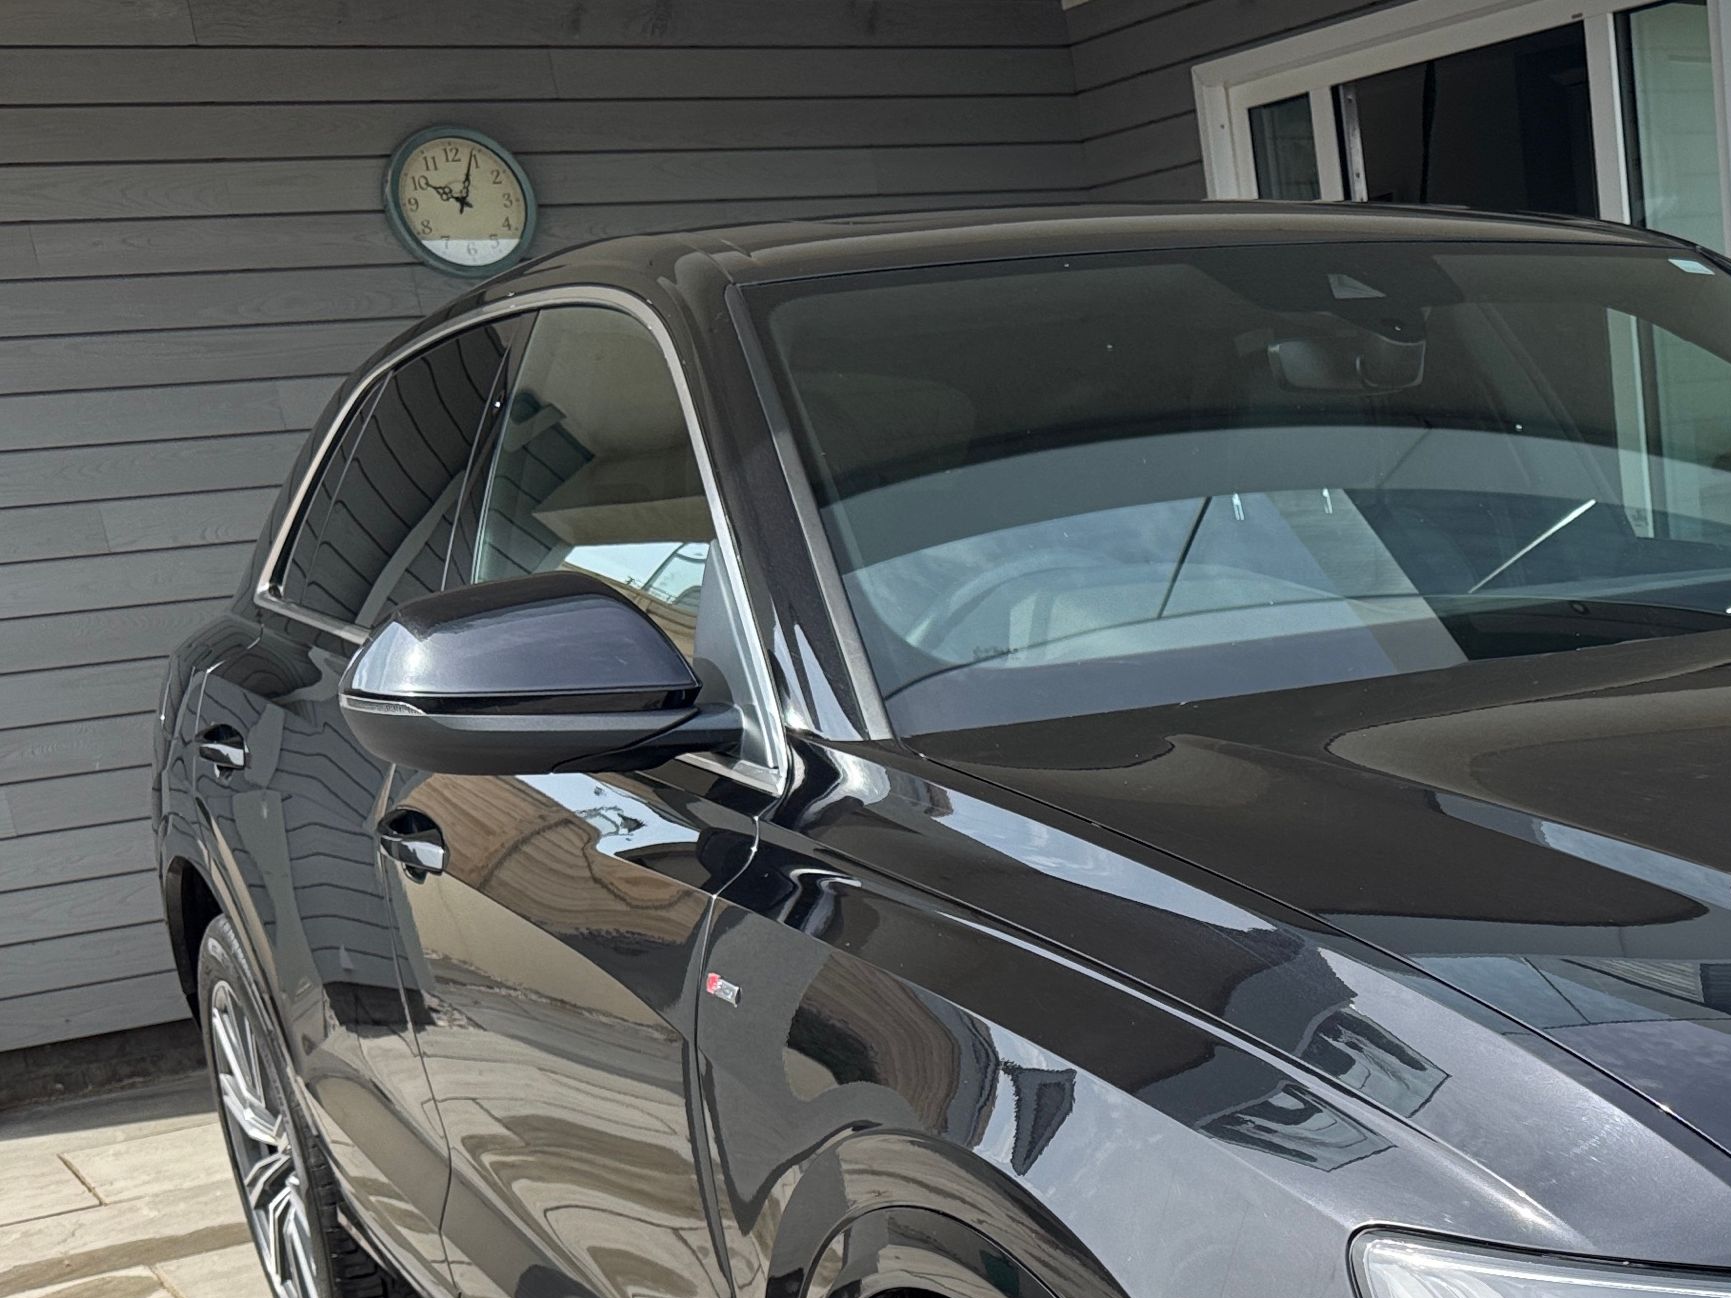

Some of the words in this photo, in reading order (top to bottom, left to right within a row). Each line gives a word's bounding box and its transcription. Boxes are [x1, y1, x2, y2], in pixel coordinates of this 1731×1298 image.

[443, 147, 462, 163] 12
[422, 156, 438, 171] 11
[411, 175, 429, 191] 10
[491, 169, 503, 185] 2
[407, 197, 419, 212] 9
[502, 193, 513, 208] 3
[420, 219, 432, 235] 8
[502, 216, 512, 231] 4
[467, 242, 478, 256] 6
